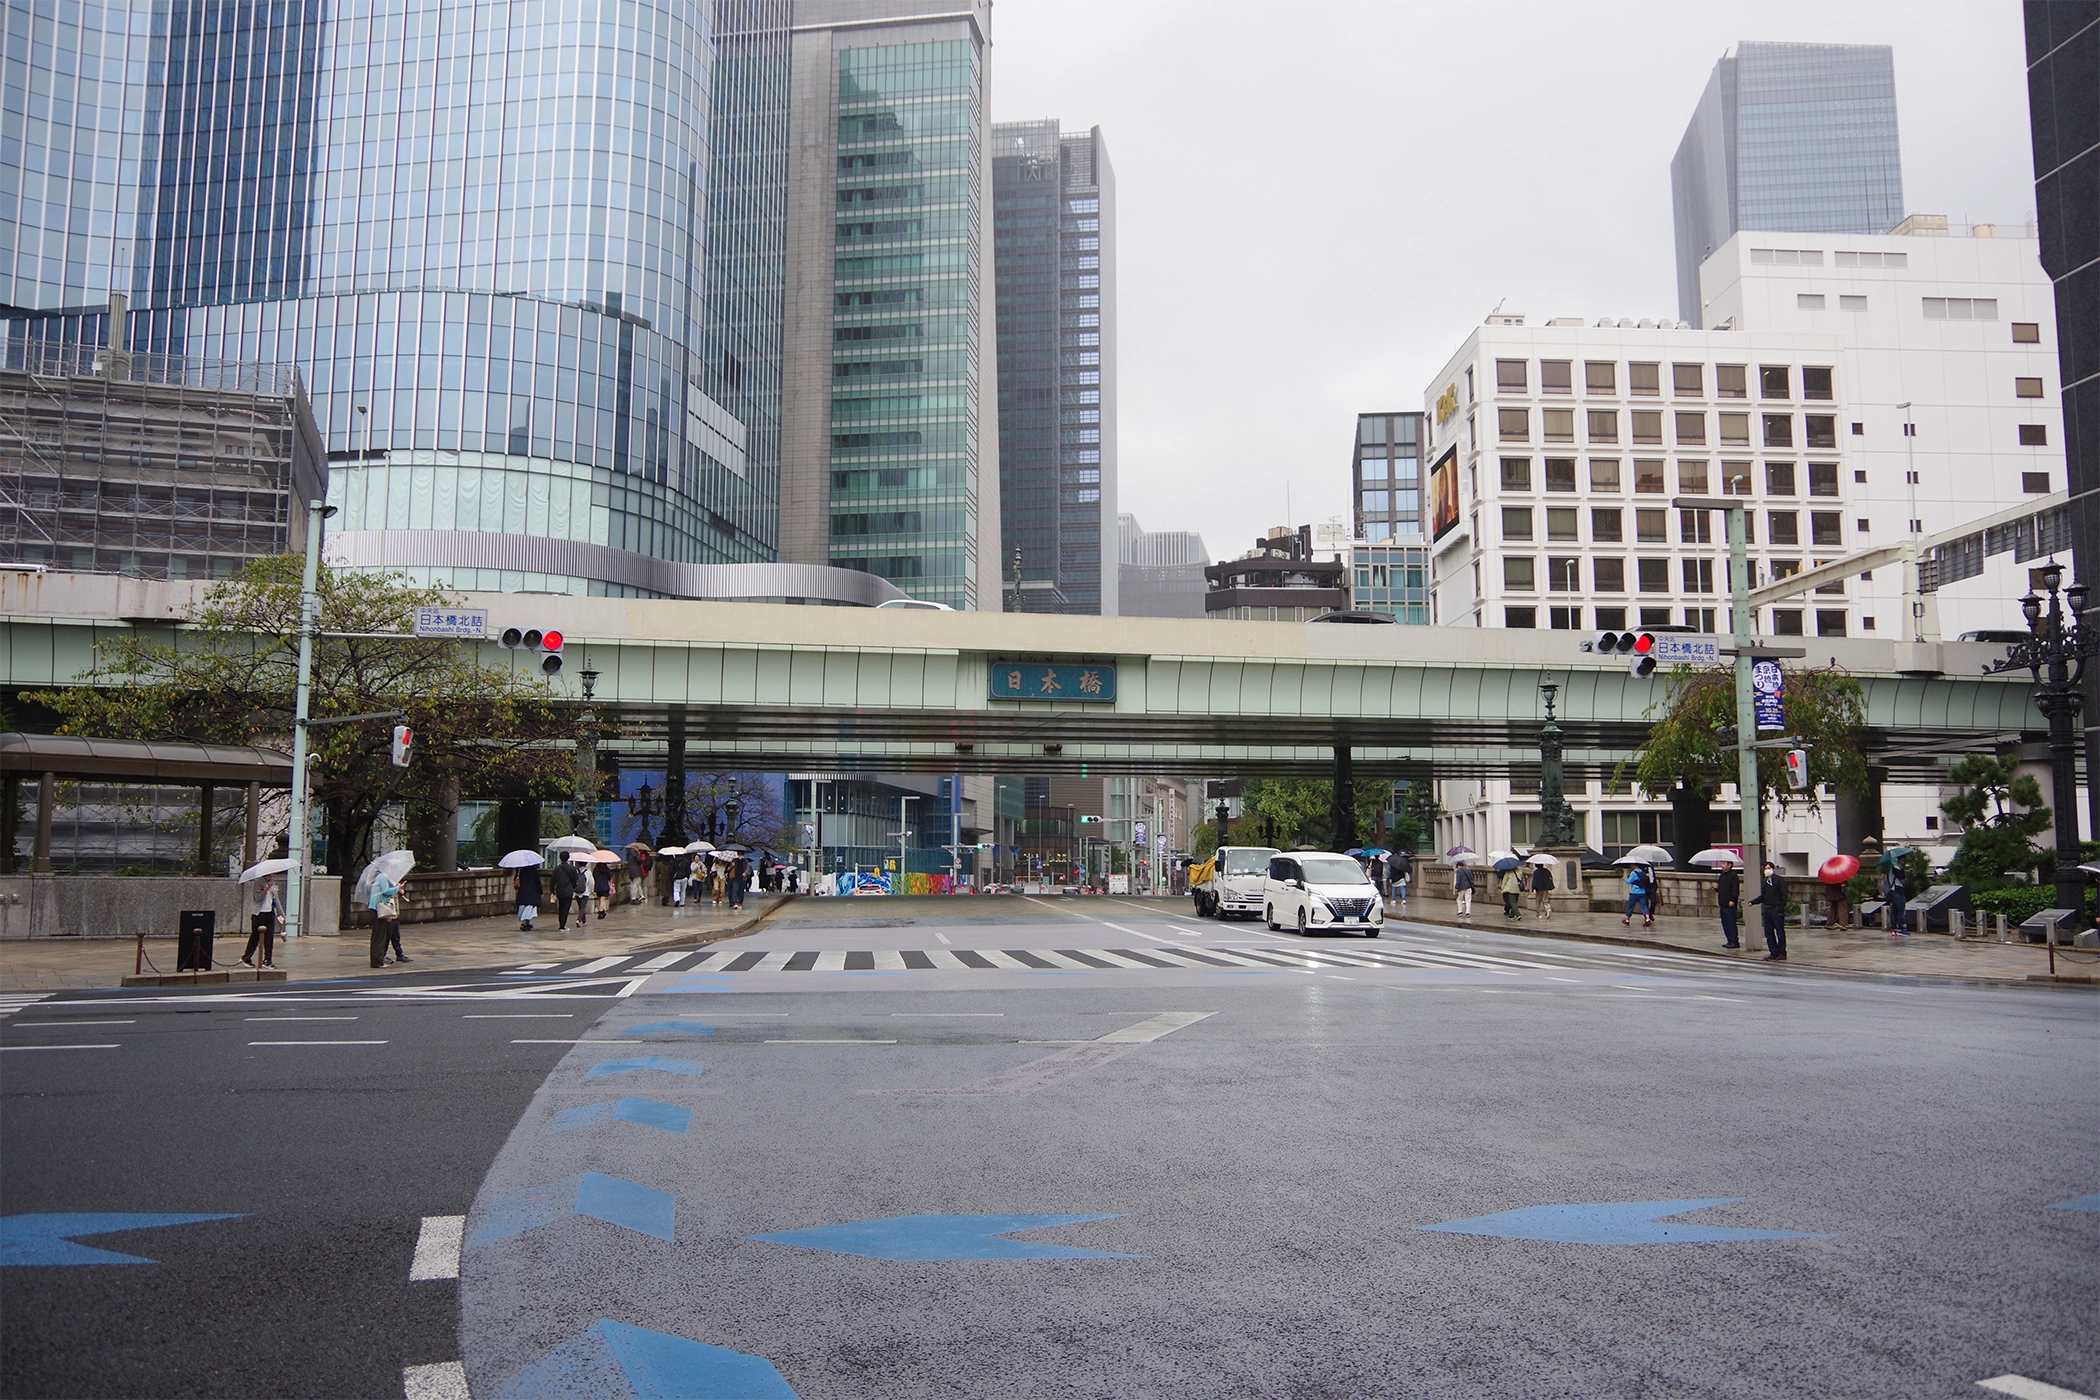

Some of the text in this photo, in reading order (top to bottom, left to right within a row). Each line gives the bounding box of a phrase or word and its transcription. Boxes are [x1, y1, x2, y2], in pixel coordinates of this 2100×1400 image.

[420, 614, 482, 626] 日本橋北詰
[1659, 642, 1714, 655] 日本橋北詰
[1007, 668, 1103, 695] 日本橋
